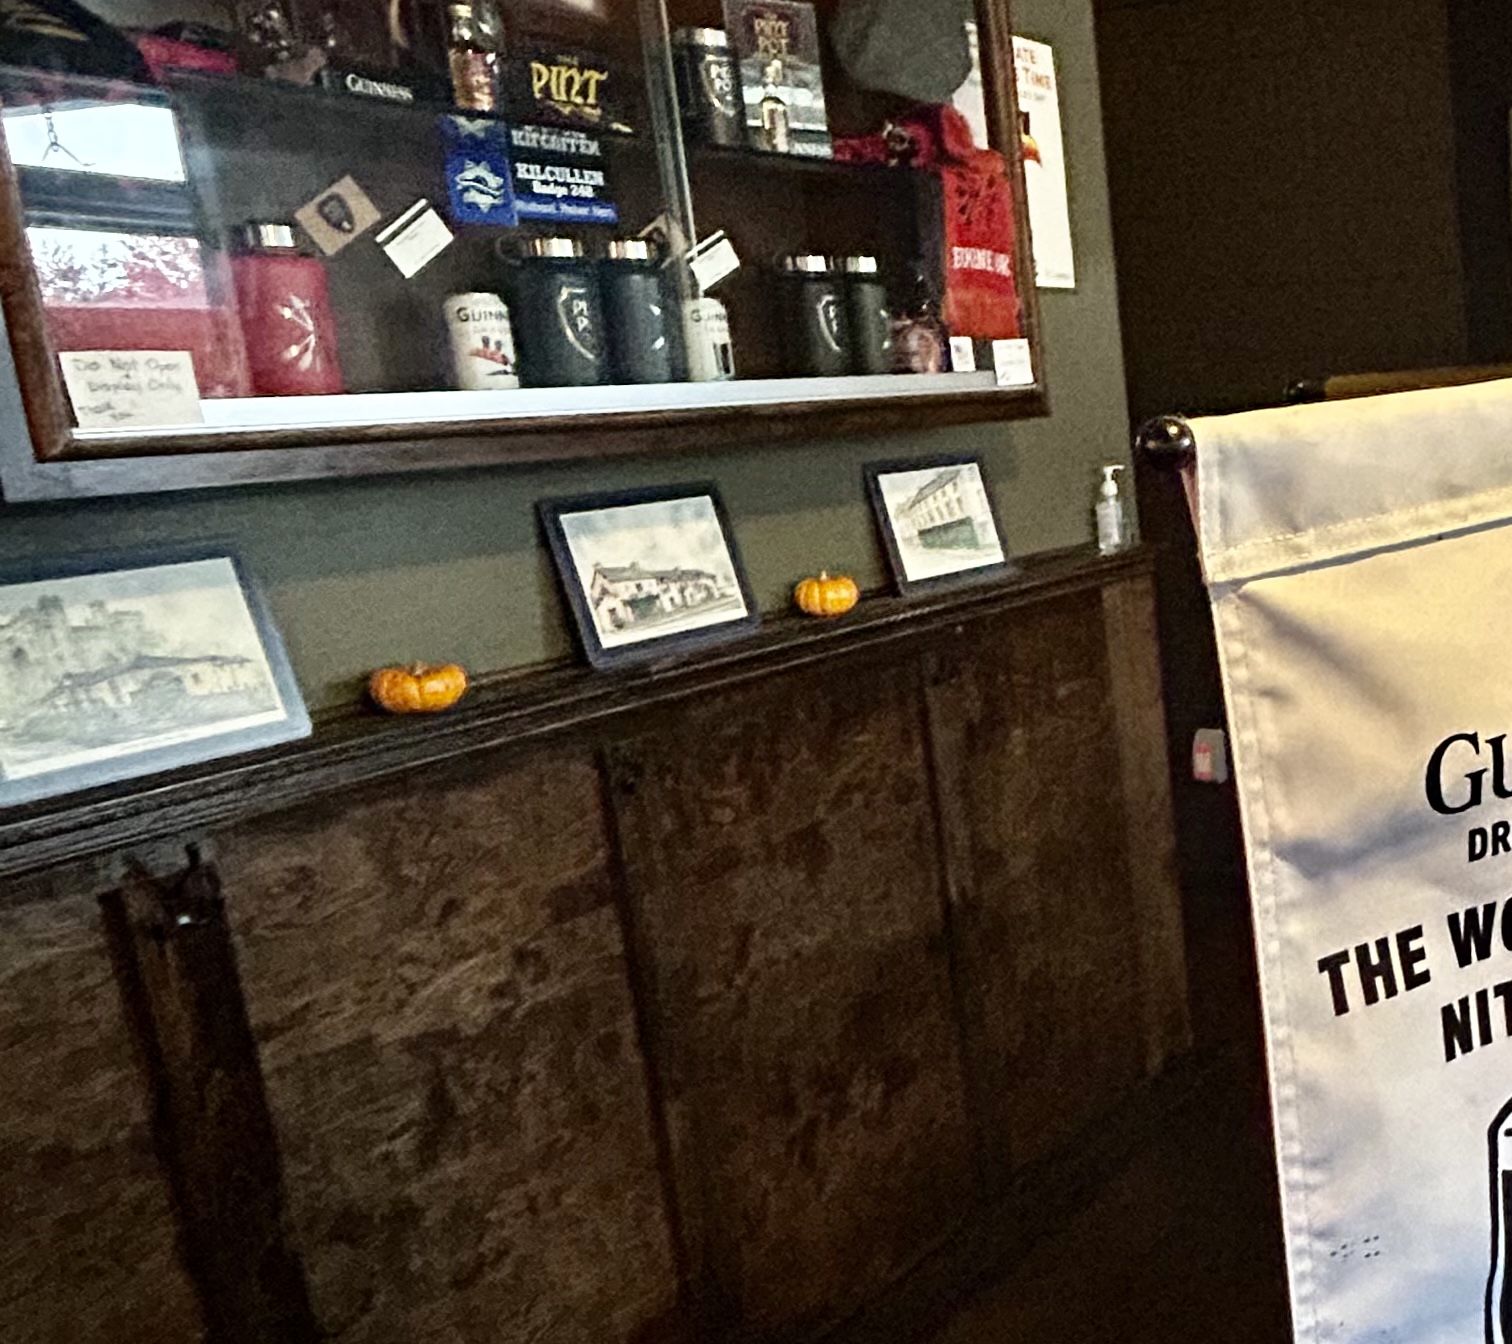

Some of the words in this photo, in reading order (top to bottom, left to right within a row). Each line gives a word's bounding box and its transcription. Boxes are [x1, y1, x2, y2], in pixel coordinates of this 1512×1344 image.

[530, 61, 608, 105] PINT
[456, 306, 509, 323] GUINN
[1318, 924, 1432, 1017] THE
